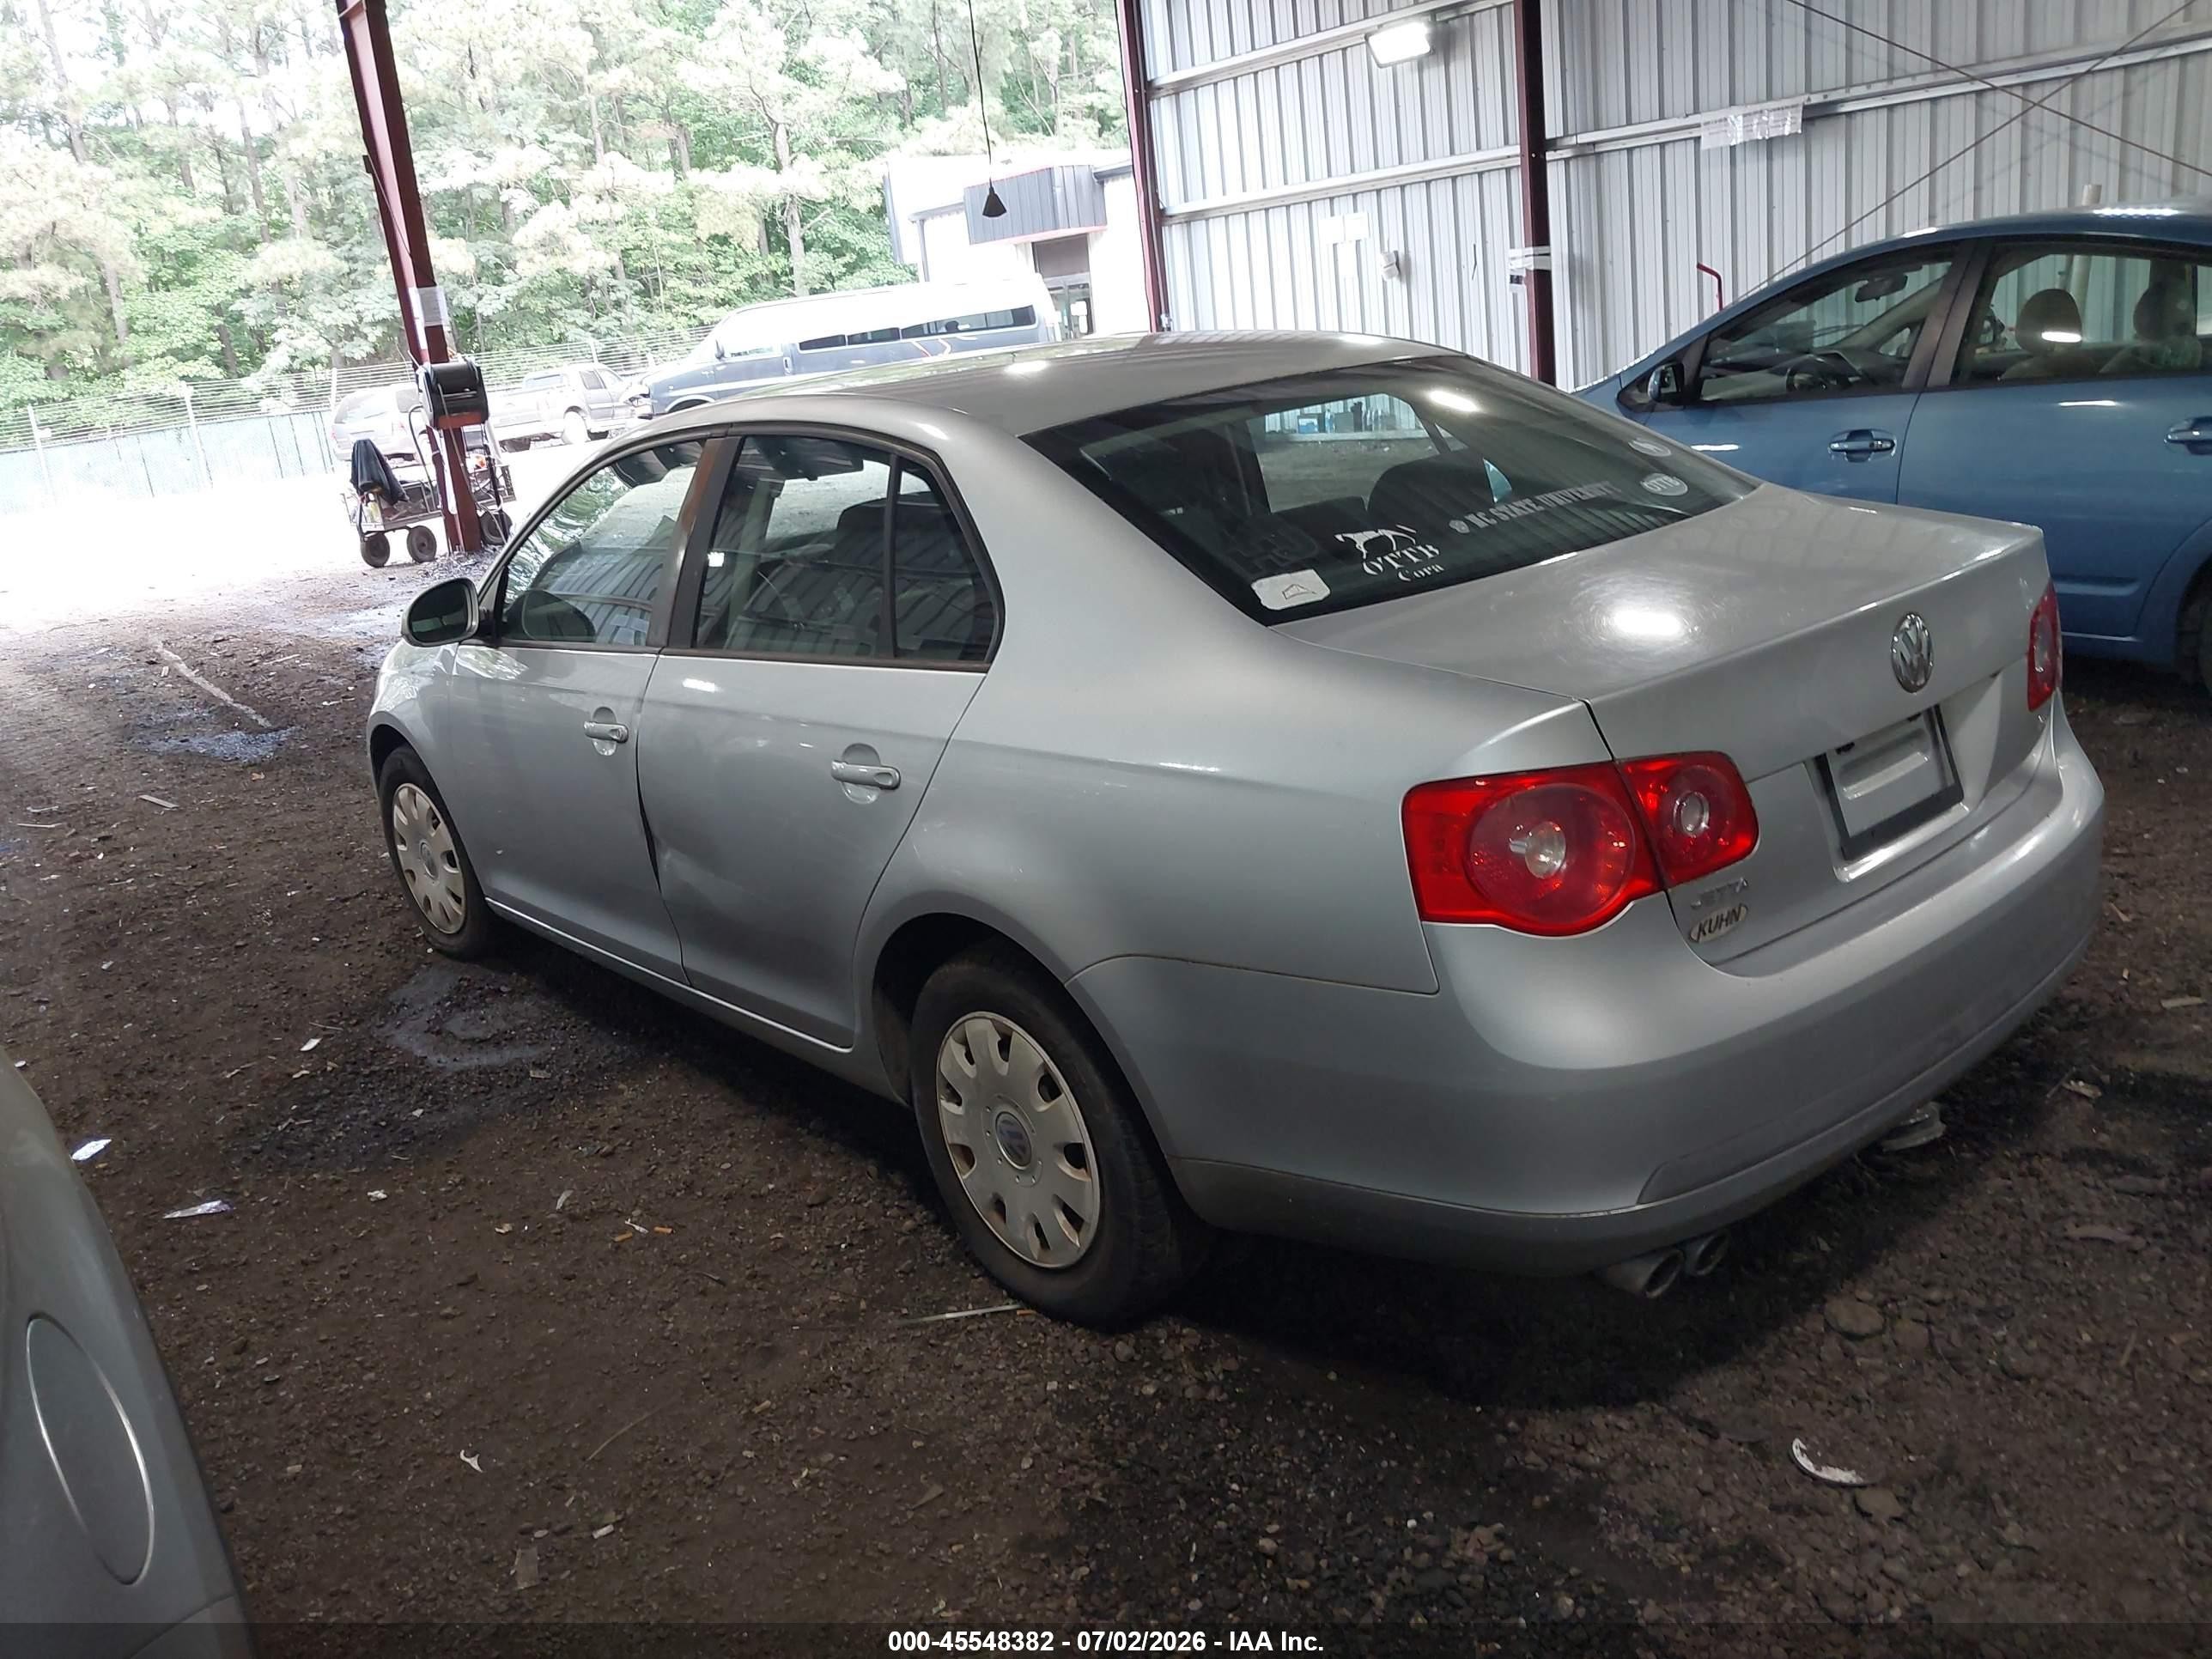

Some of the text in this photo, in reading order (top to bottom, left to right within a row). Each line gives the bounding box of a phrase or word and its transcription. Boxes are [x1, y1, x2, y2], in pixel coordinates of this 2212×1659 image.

[1534, 481, 1622, 508] UNIVER
[1363, 544, 1440, 575] OTTB
[1695, 903, 1743, 942] KUHN
